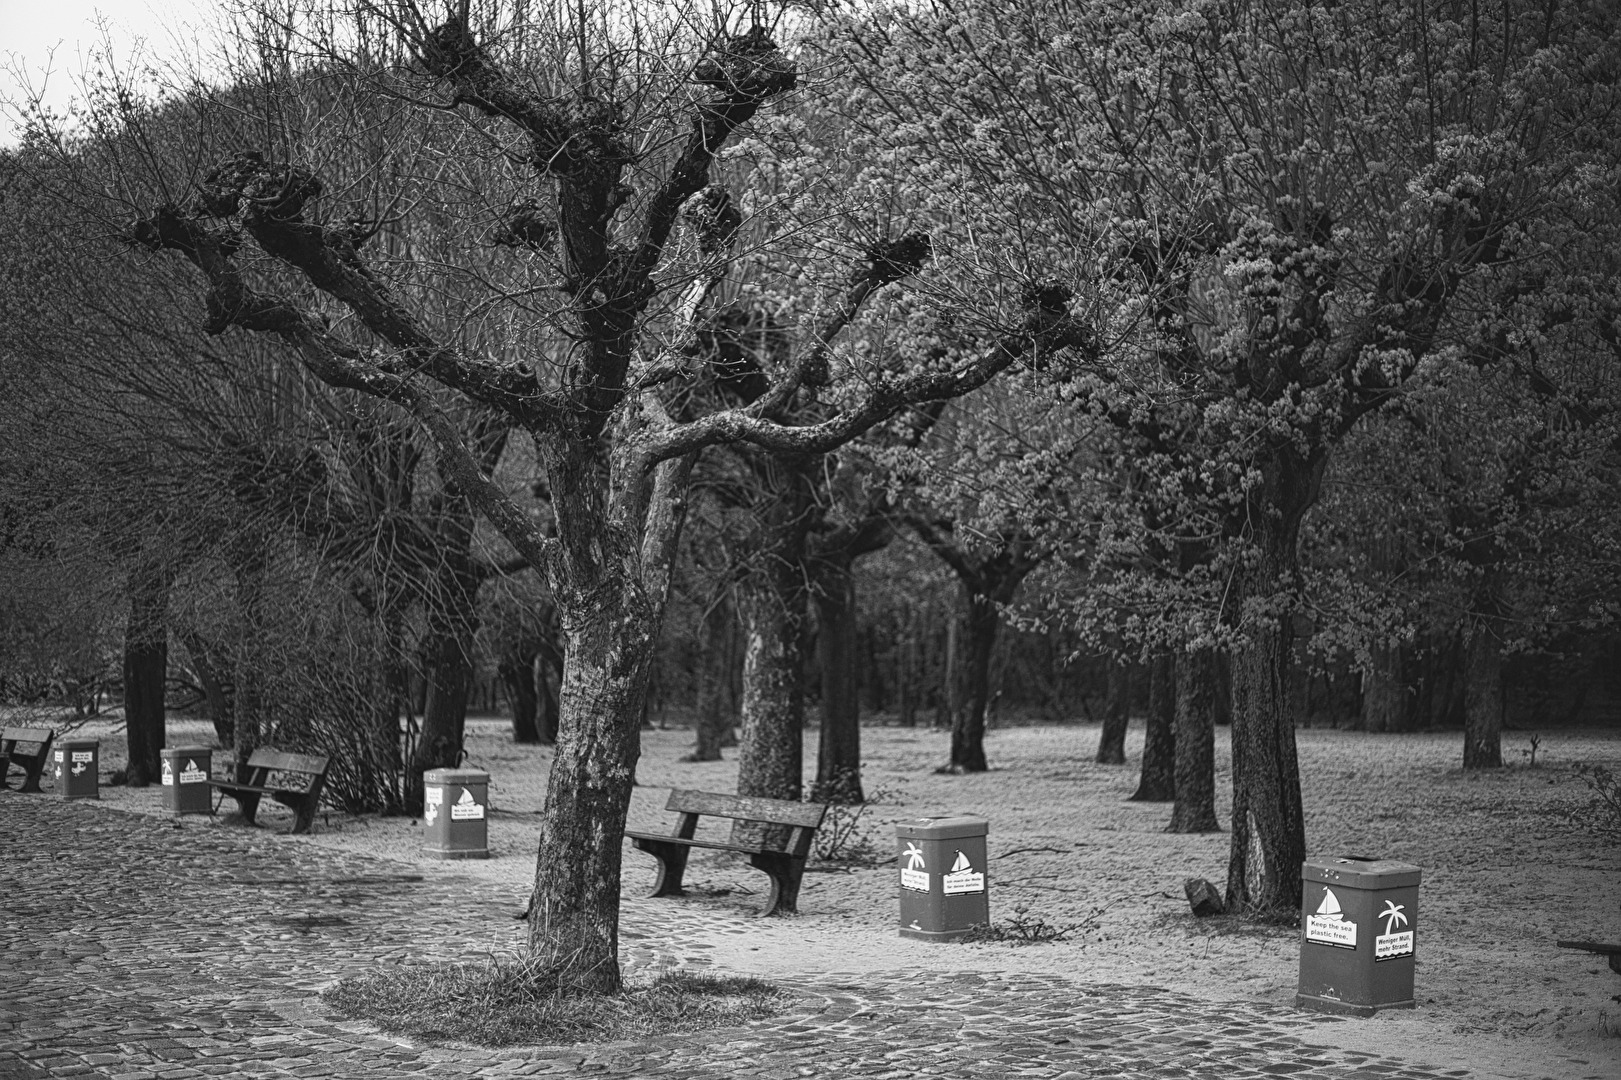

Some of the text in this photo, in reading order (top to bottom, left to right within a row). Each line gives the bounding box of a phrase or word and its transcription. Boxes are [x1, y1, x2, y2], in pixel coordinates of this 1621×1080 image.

[1311, 920, 1326, 928] Keep
[1328, 923, 1339, 931] the
[1310, 929, 1348, 940] plastic free.
[1378, 937, 1398, 945] Weniger
[1391, 942, 1409, 951] Strand.
